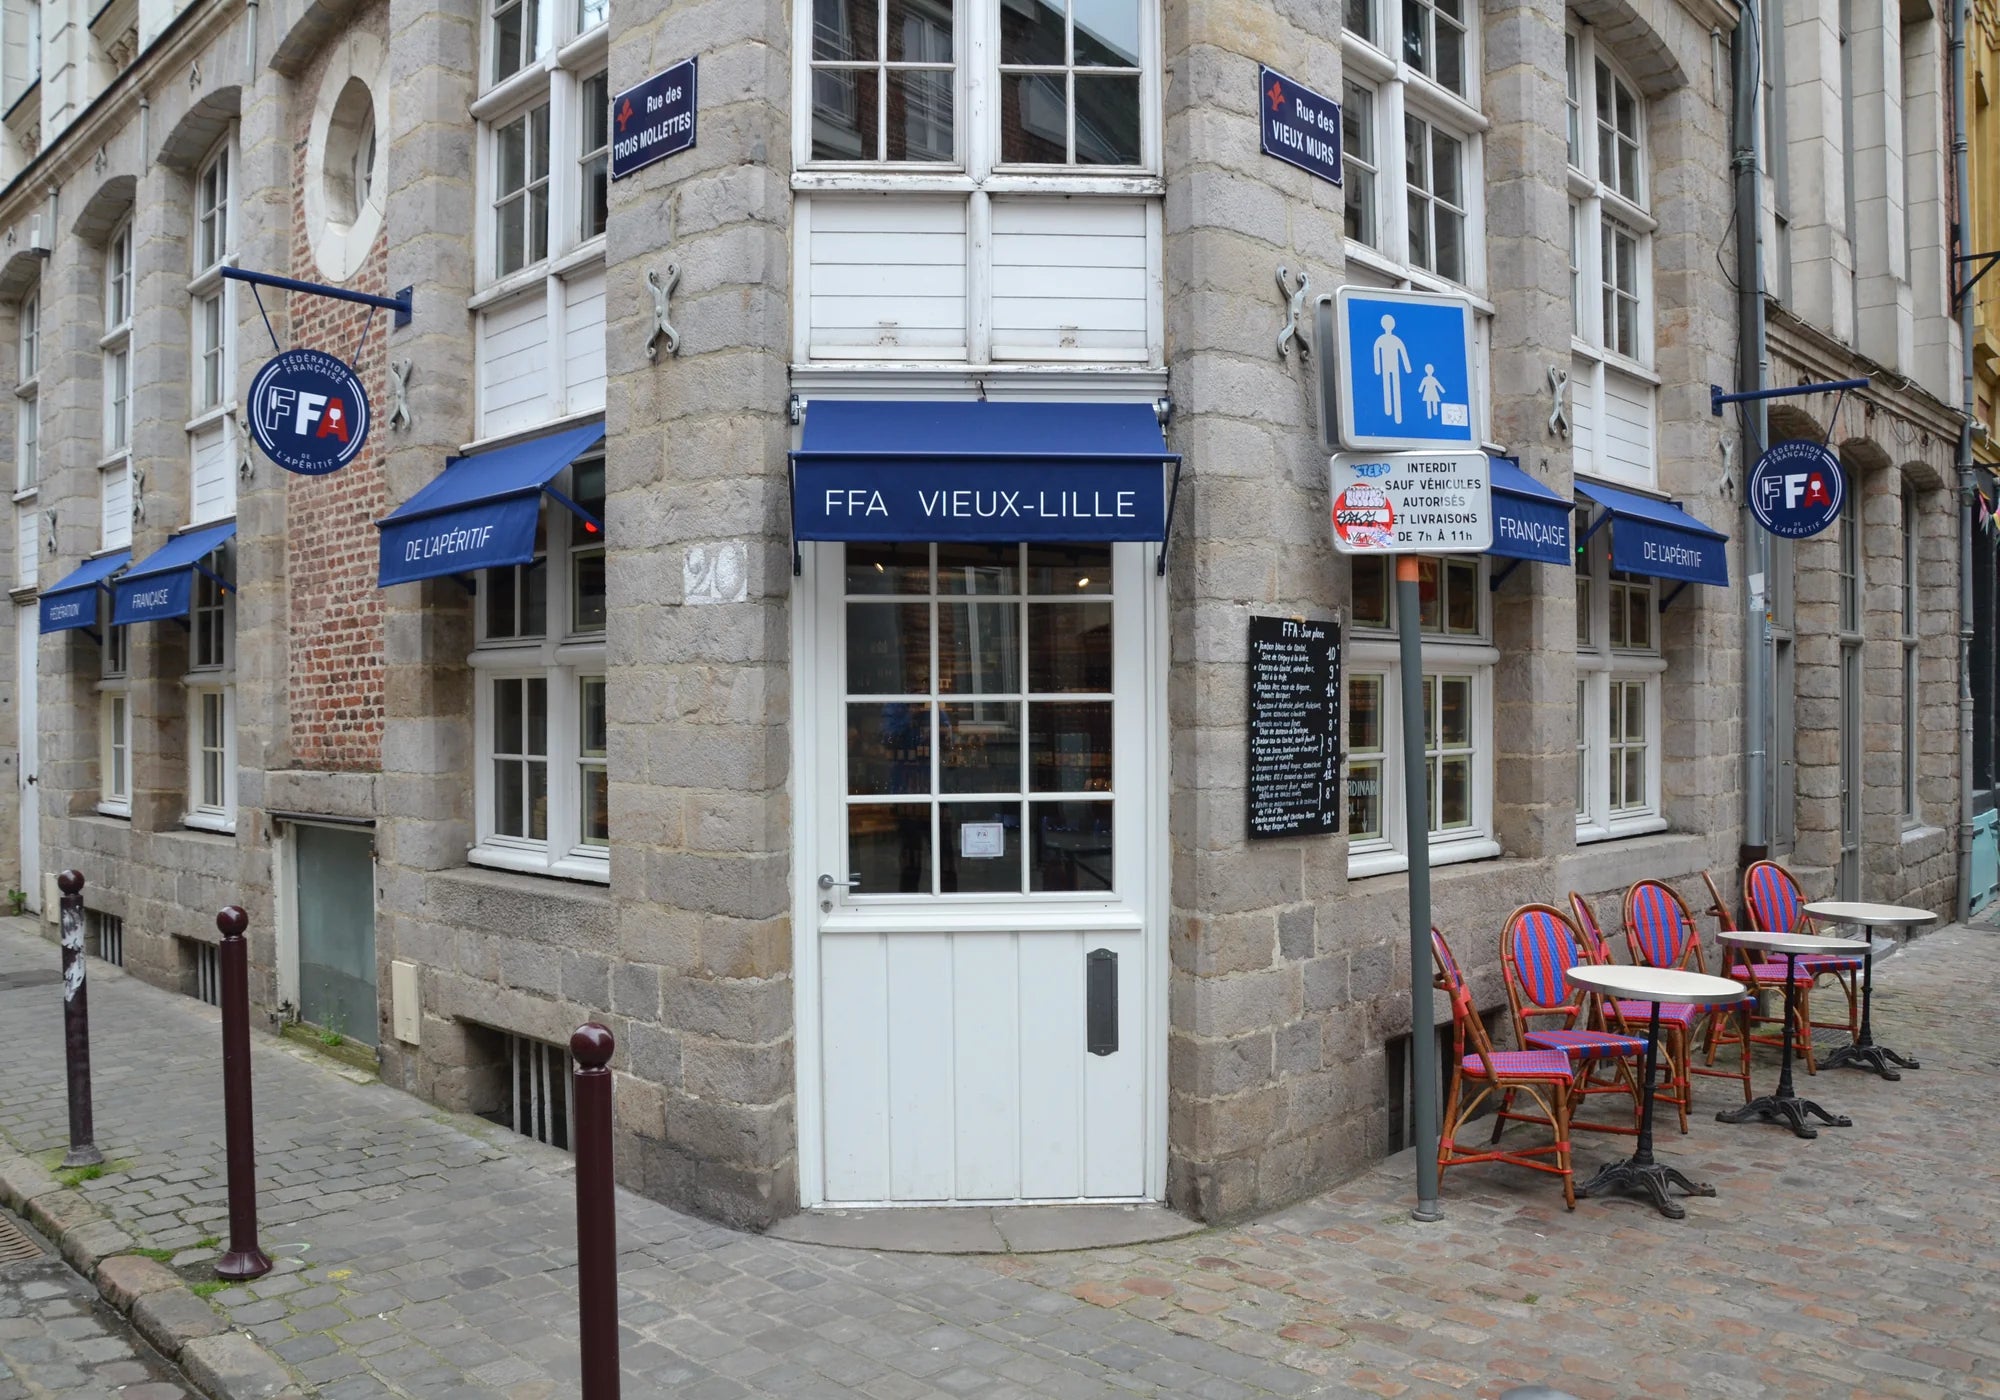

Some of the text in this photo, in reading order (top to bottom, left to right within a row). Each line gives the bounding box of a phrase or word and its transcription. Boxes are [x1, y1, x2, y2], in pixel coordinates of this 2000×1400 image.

[647, 86, 682, 114] Rue des
[1296, 98, 1334, 134] Rue des
[614, 112, 690, 160] TROIS MOLLETTES
[1272, 120, 1334, 166] VIEUX MURS
[282, 353, 348, 378] FÉDÉRATION
[286, 364, 342, 384] FRANÇAISE
[266, 386, 348, 442] FFA
[1768, 444, 1821, 460] FÉDÉRATION
[1772, 451, 1817, 464] FRANÇAISE
[1408, 462, 1456, 473] INTERDIT
[1385, 478, 1481, 490] SAUF VÉHICULES
[1762, 472, 1831, 510] FFA
[826, 490, 1136, 518] FFA VIEUX-LILLE
[1402, 496, 1465, 507] AUTORISÉS
[1392, 514, 1478, 524] ET LIVRAISONS
[405, 526, 494, 562] DE L'APÉRITIF
[1398, 532, 1412, 542] DE
[1418, 531, 1432, 542] 7h
[1438, 529, 1445, 541] À
[1452, 530, 1472, 540] 11h
[1500, 516, 1566, 548] FRANÇAISE
[1644, 542, 1702, 568] DE L'APÉRITIF
[132, 588, 168, 610] FRANÇAISE
[1283, 622, 1297, 638] FFA
